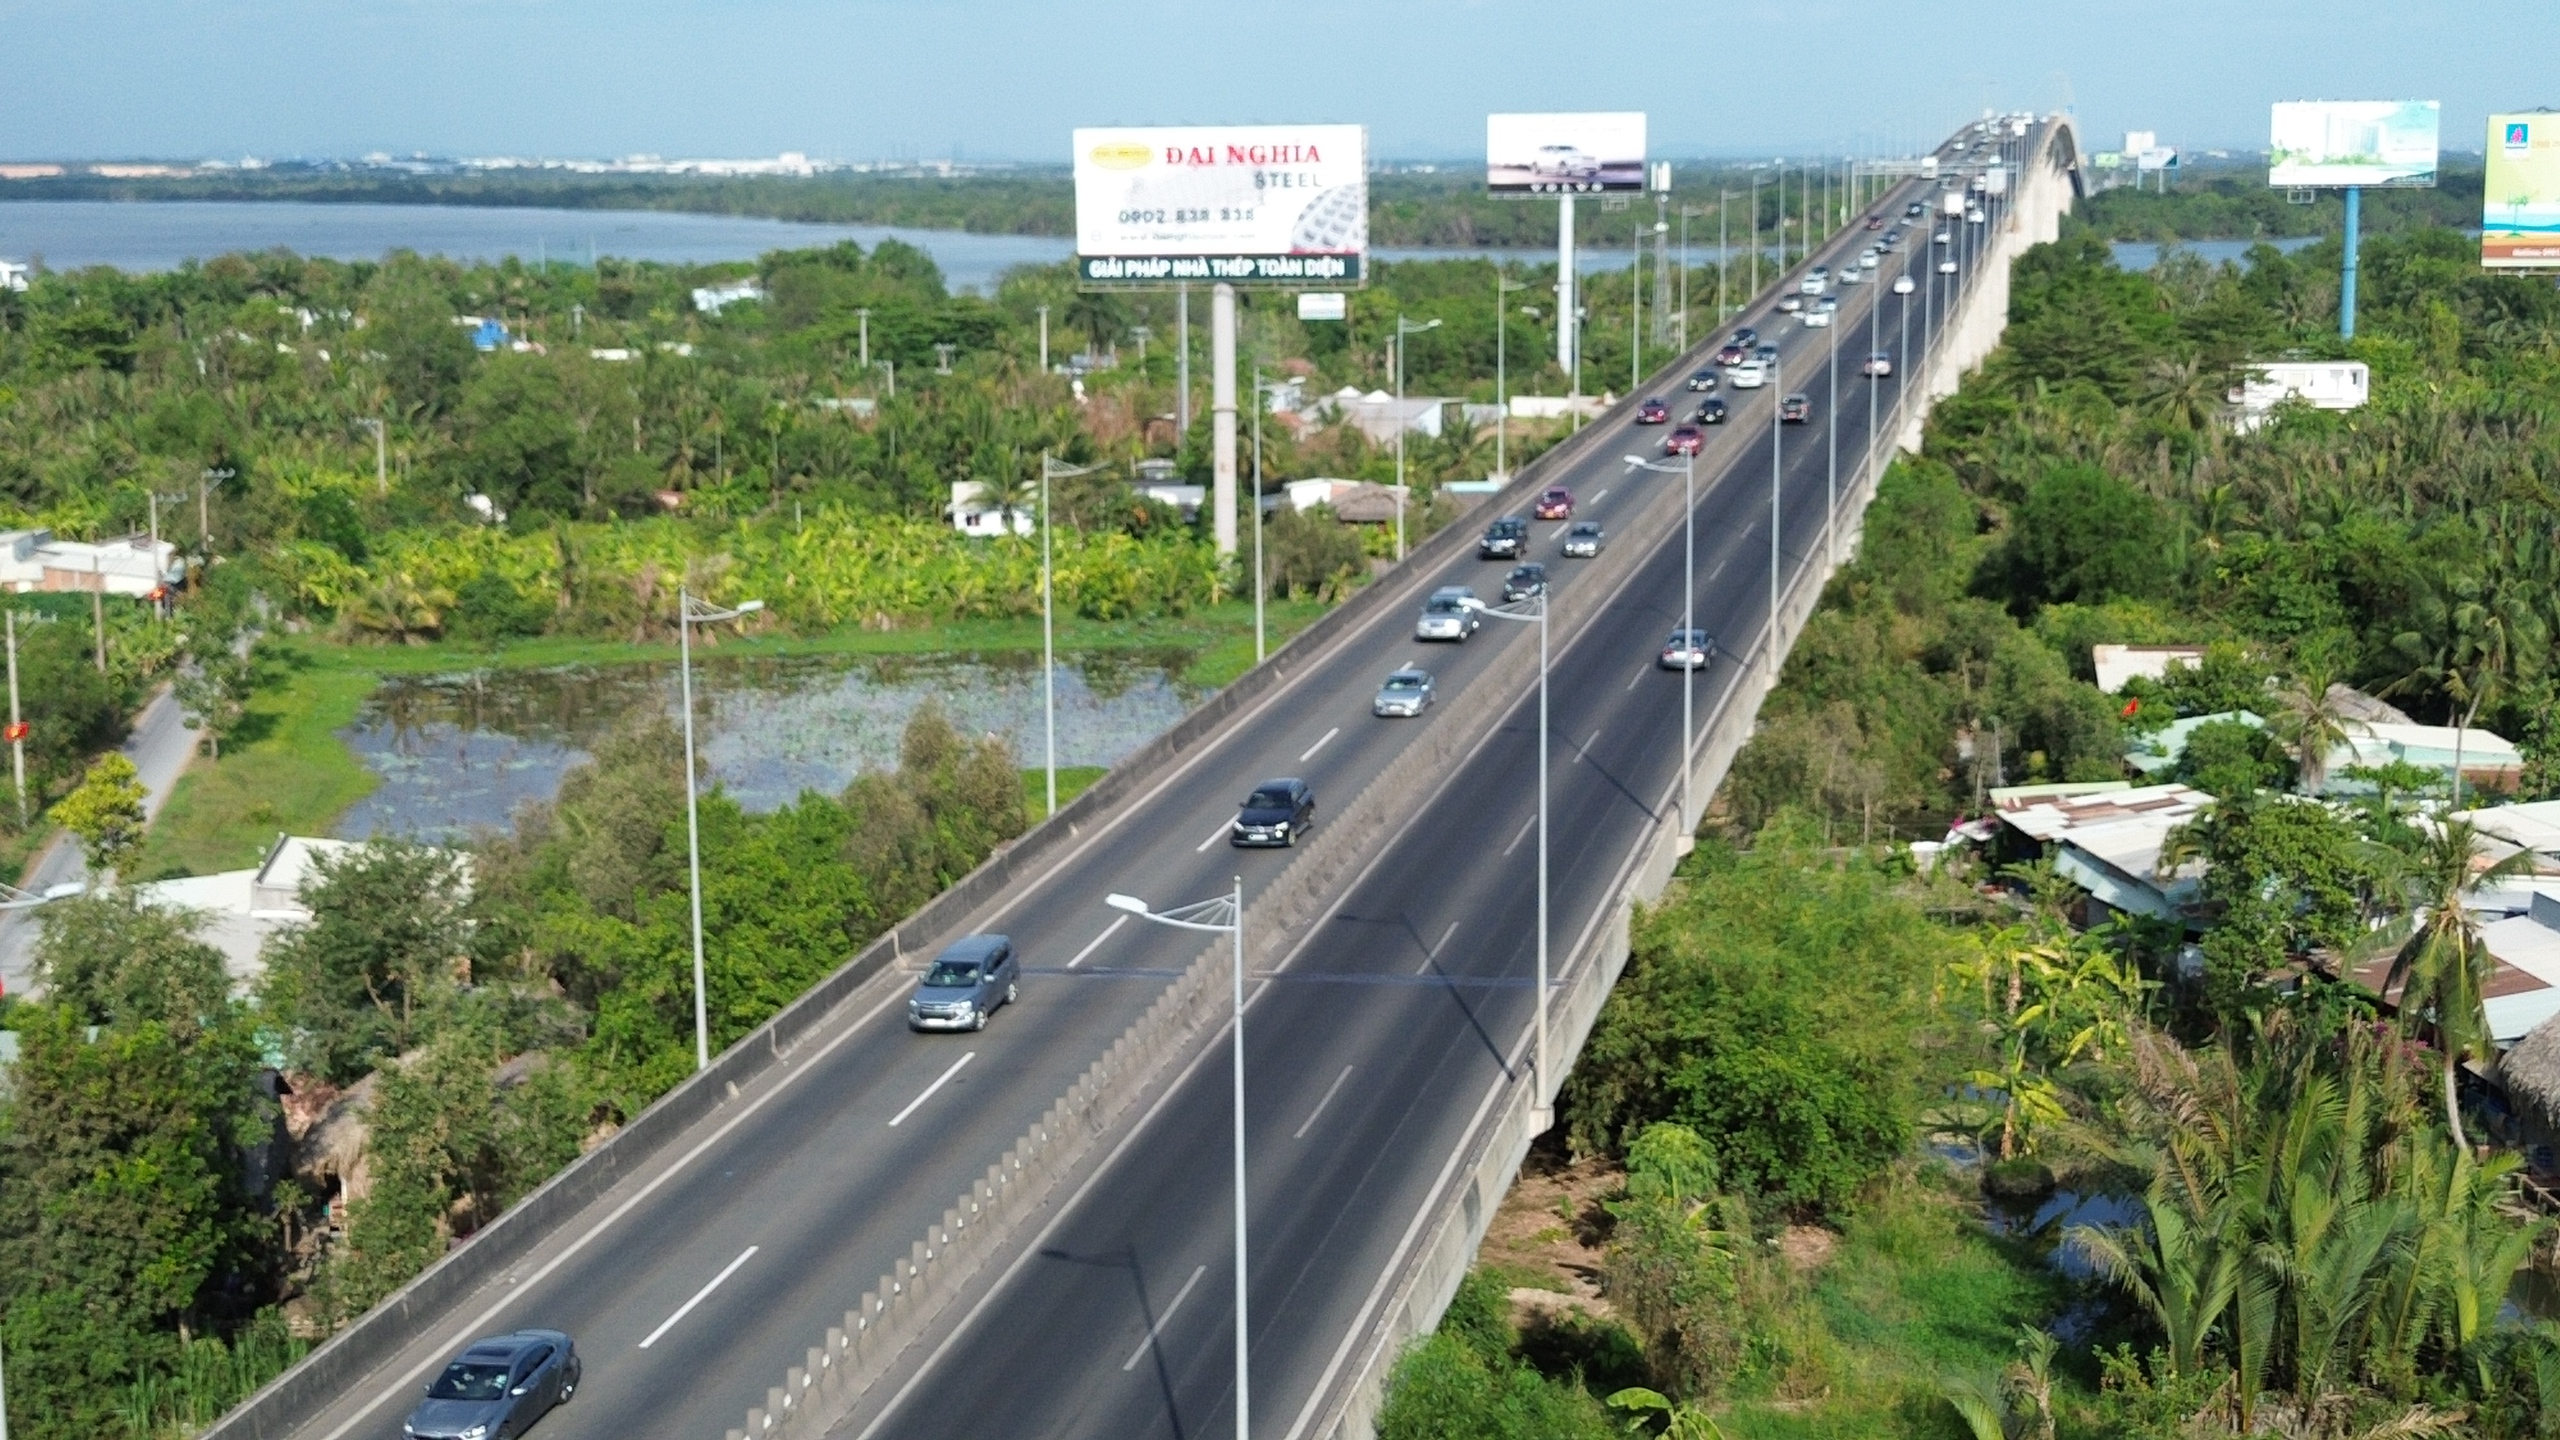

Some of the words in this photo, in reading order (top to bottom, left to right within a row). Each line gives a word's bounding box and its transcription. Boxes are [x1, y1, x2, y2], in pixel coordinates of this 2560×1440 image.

[1254, 170, 1323, 189] STEEL
[1118, 208, 1166, 224] 0902
[1125, 256, 1171, 278] PHÁP
[1172, 256, 1210, 277] NHÀ
[1211, 255, 1255, 277] THÉP
[1256, 255, 1303, 277] TOÀN
[1304, 255, 1345, 279] DIỆN
